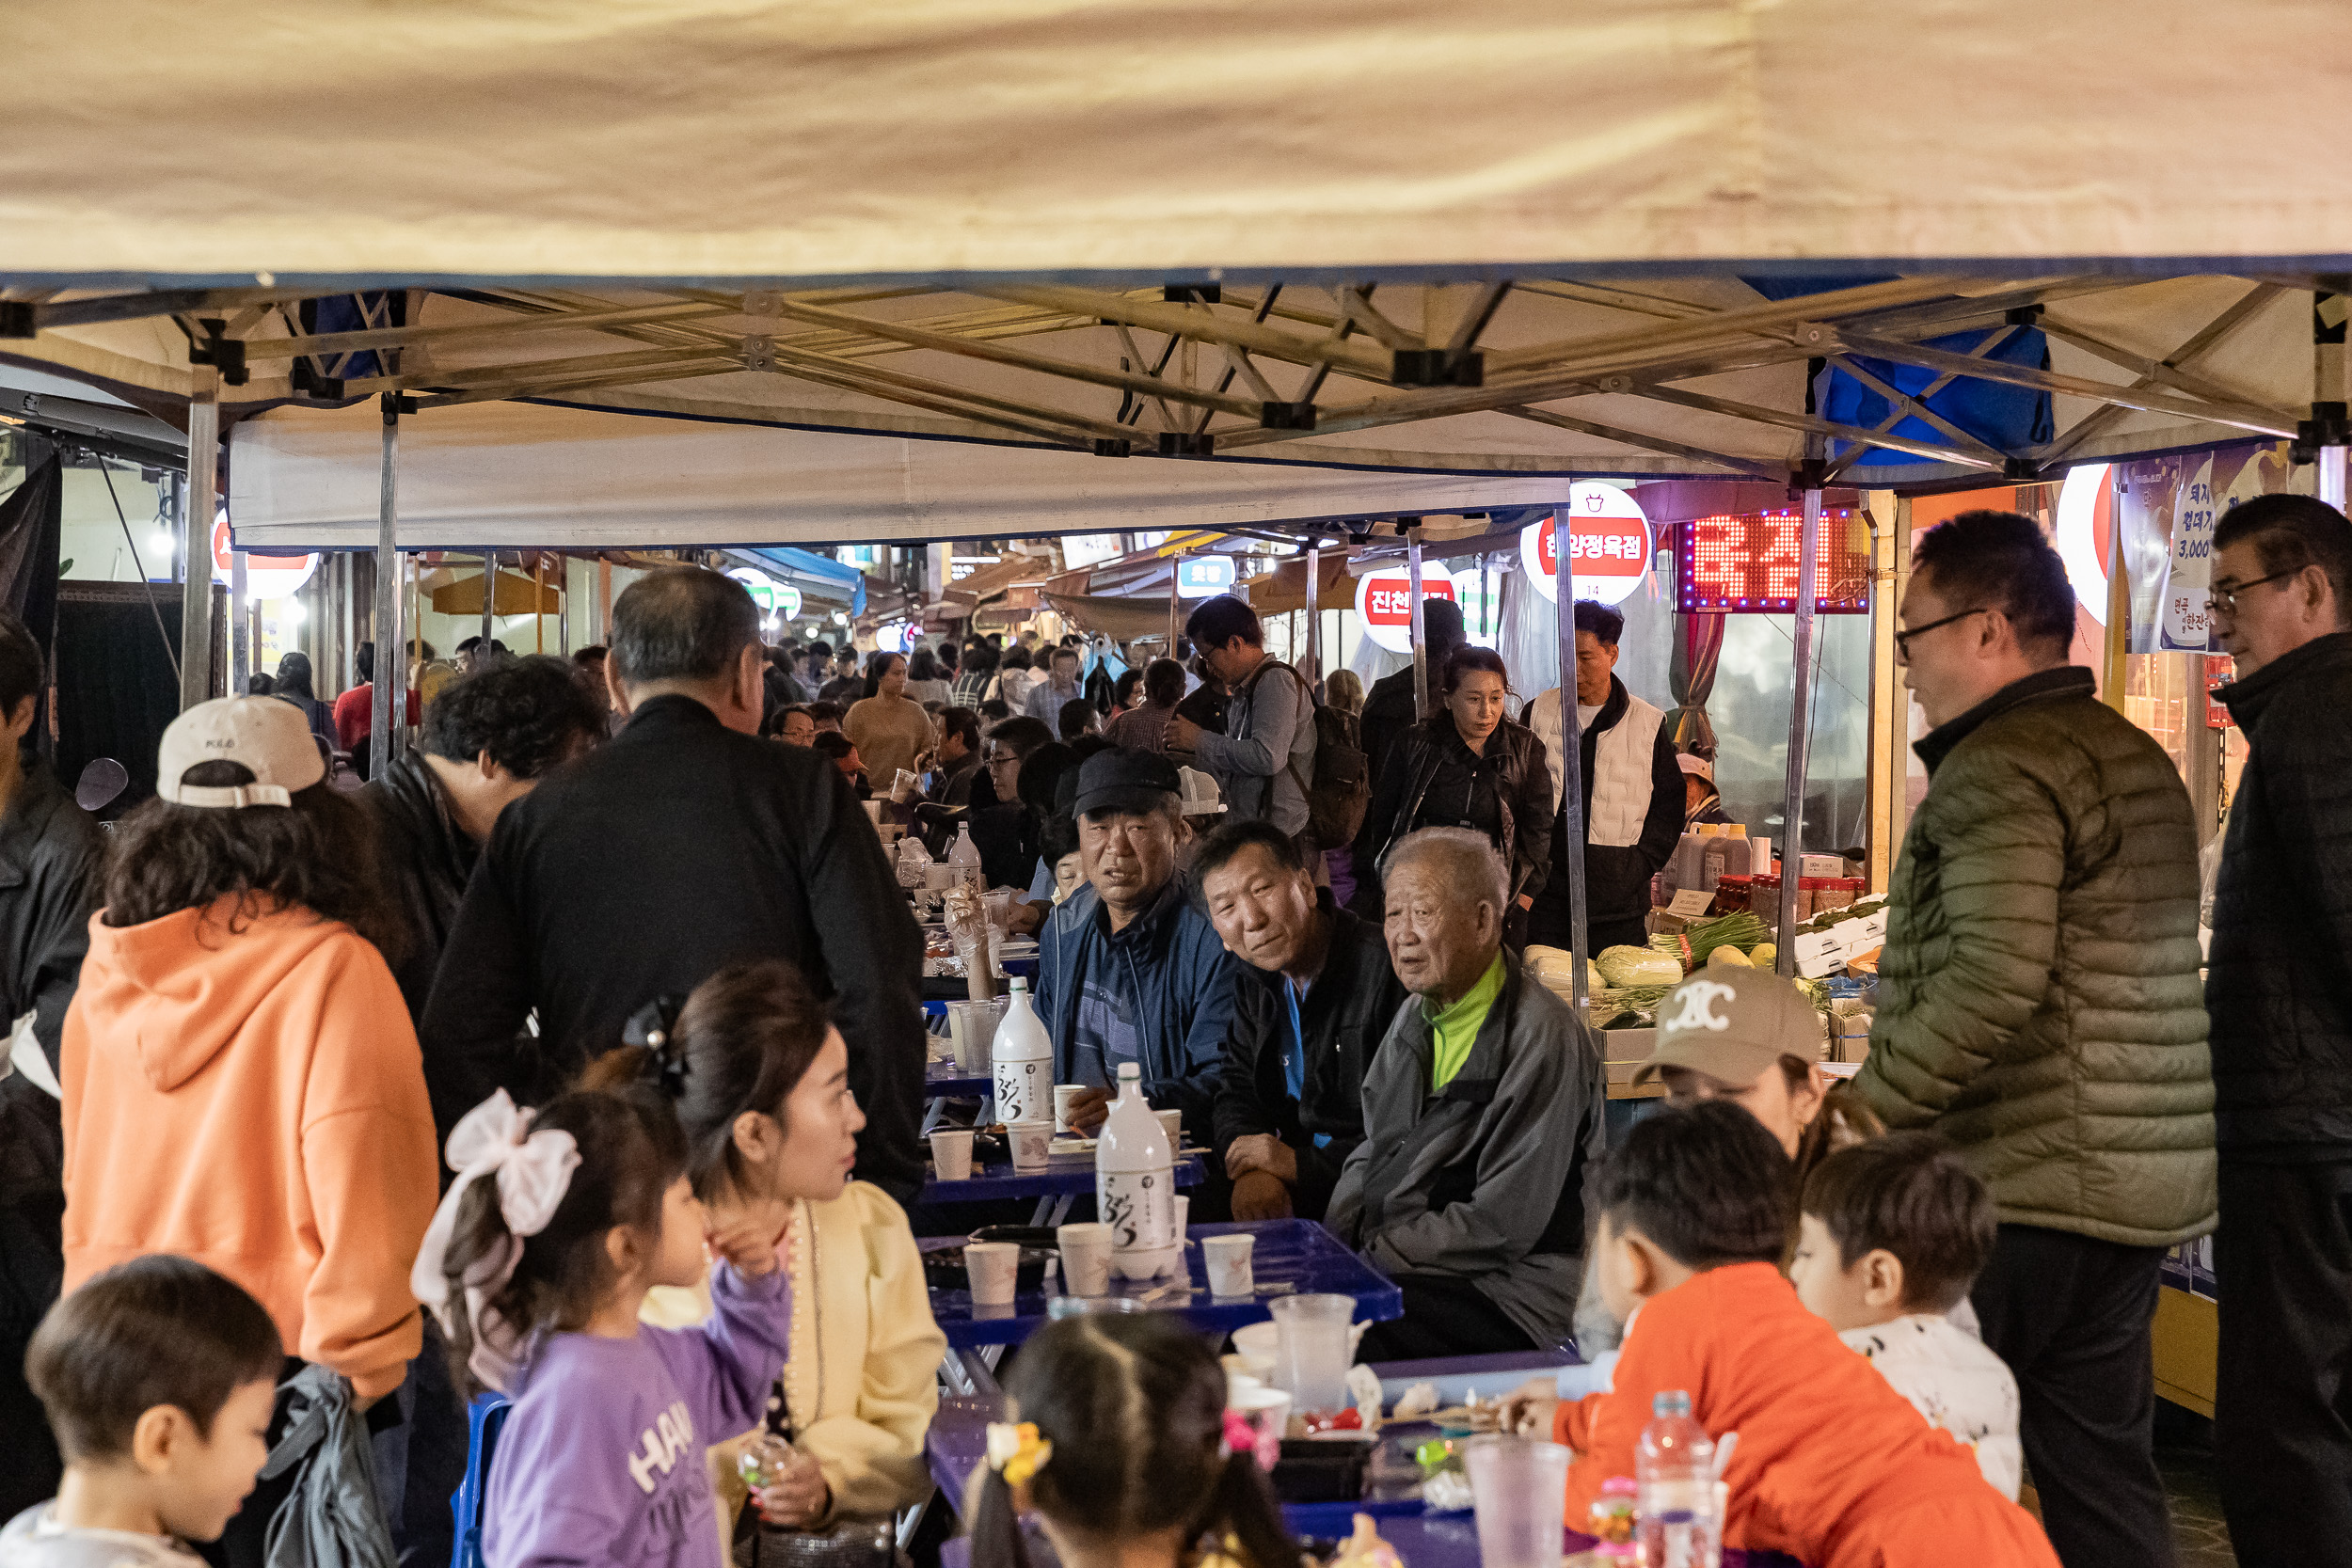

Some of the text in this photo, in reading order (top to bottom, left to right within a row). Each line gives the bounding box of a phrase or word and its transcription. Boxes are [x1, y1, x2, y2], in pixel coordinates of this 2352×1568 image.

[2189, 482, 2210, 504] 돼지
[2183, 510, 2213, 531] 껍데기
[2179, 539, 2209, 560] 3,000
[1587, 585, 1599, 595] 14
[1371, 590, 1449, 614] 진천
